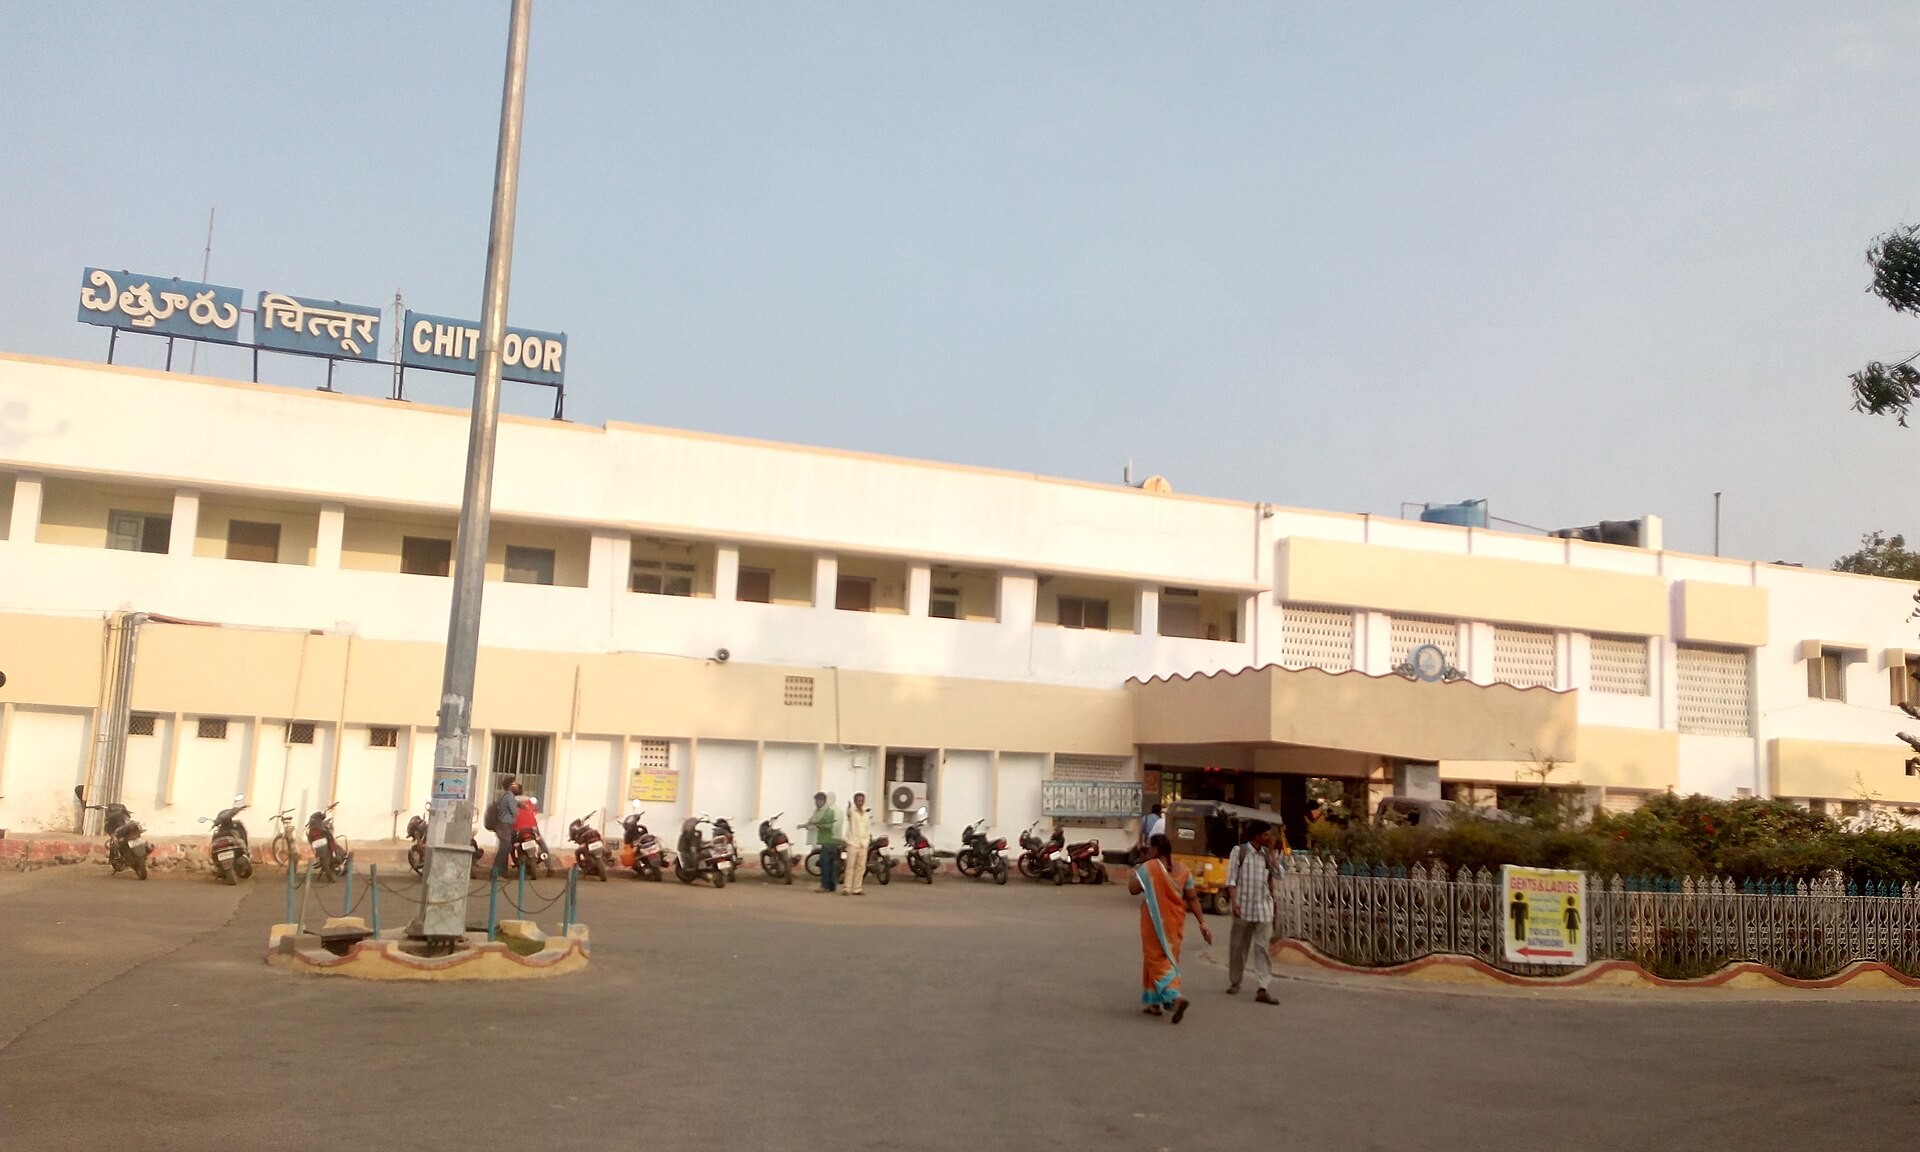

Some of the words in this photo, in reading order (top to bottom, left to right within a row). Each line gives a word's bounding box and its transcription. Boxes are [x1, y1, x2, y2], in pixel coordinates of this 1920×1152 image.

[81, 270, 239, 329] చిత్తూరు
[262, 293, 379, 355] चित्तूर
[412, 320, 563, 373] CHITOOR
